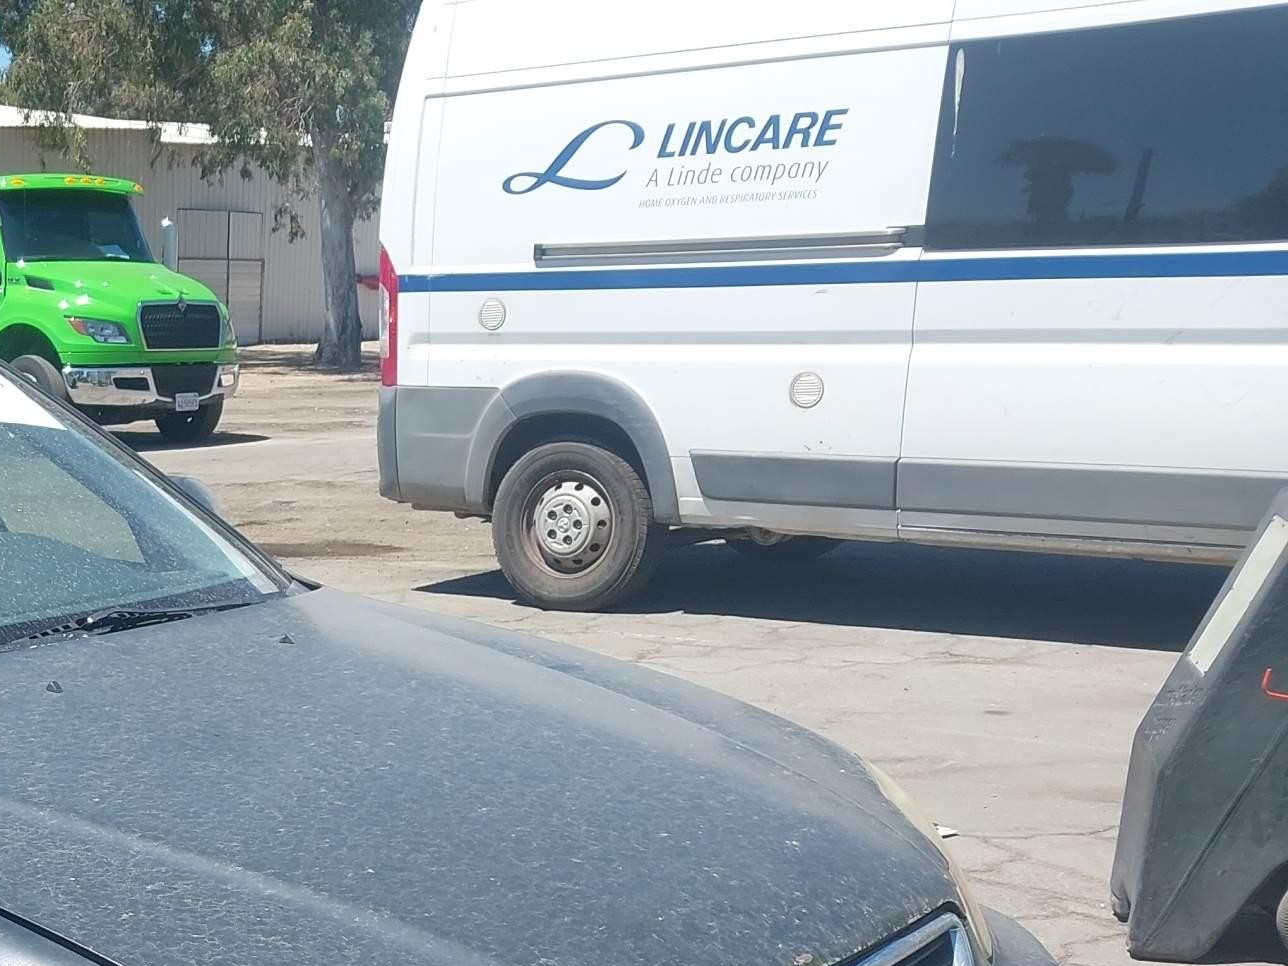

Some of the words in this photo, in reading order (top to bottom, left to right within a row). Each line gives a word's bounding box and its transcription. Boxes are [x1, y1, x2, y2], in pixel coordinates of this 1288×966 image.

[657, 108, 850, 158] LINCARE
[645, 168, 658, 188] A
[667, 162, 722, 187] Linde
[730, 160, 830, 186] company
[638, 199, 663, 209] HOME
[664, 196, 698, 207] OXYGEN
[699, 194, 718, 205] AND
[719, 191, 776, 204] RESPIRATORY
[777, 189, 817, 201] SERVICES
